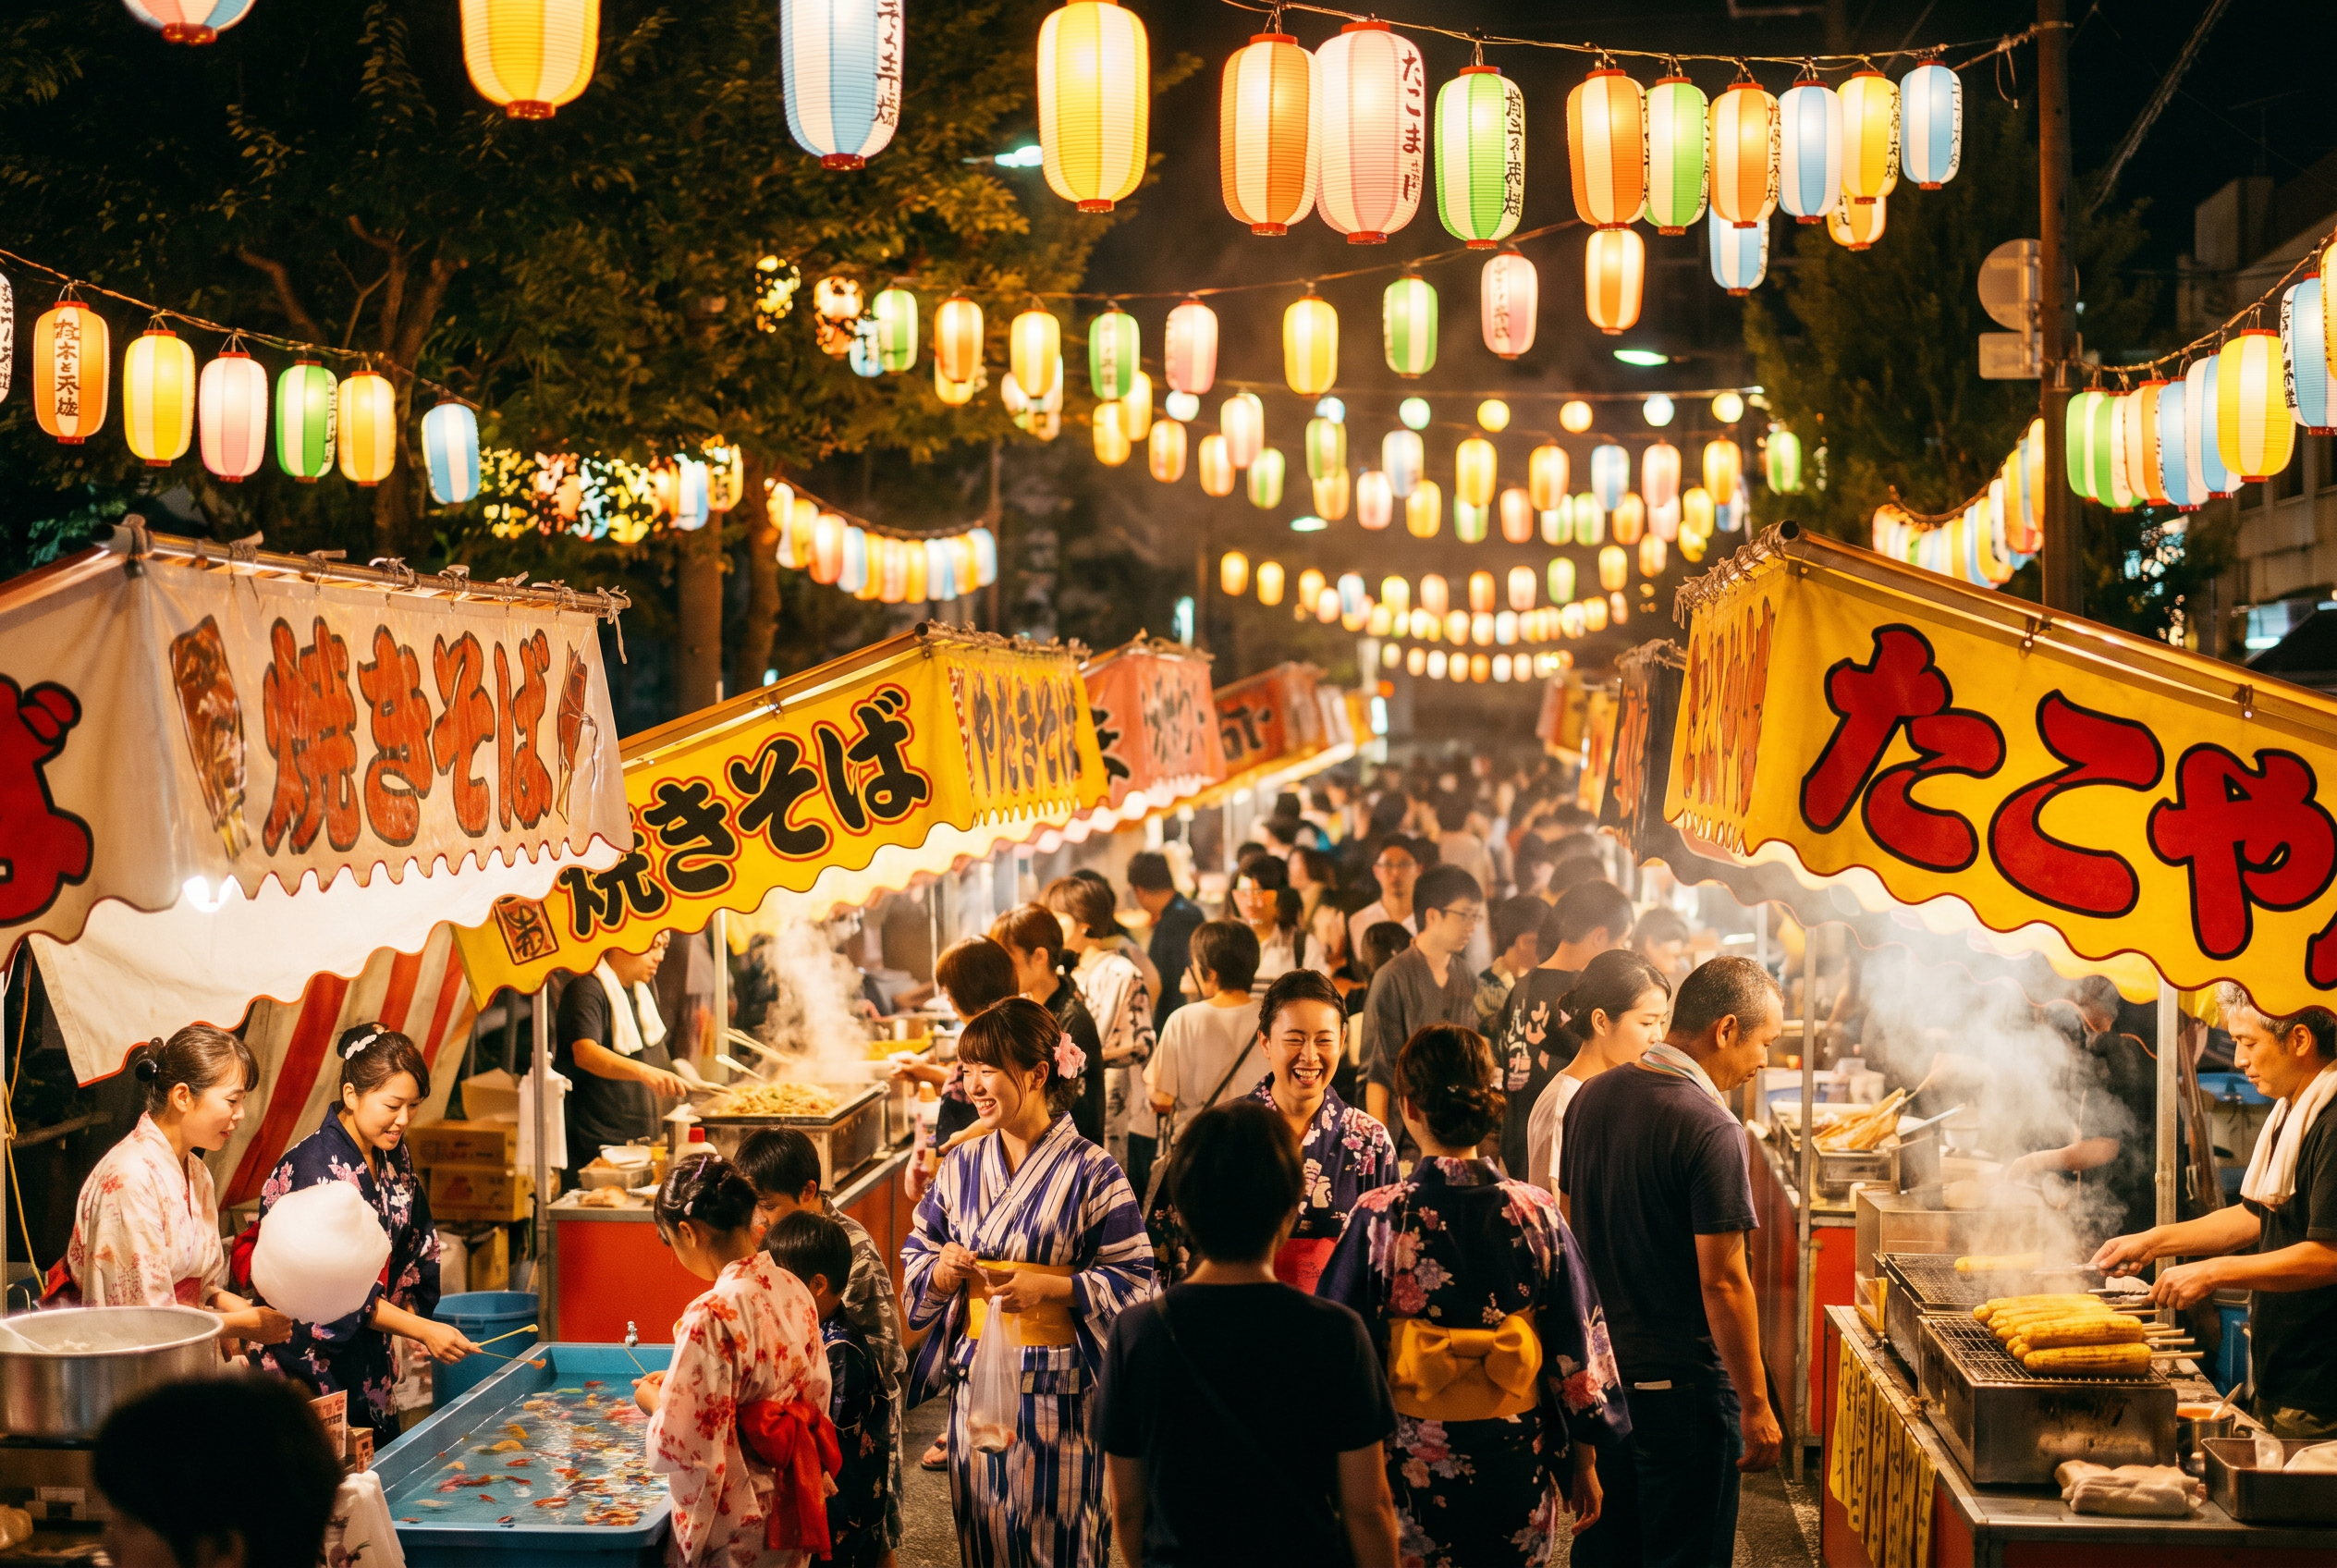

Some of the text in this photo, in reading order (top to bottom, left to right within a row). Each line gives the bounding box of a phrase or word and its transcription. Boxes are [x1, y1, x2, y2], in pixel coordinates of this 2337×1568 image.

[263, 615, 553, 857] 焼きそば
[1799, 622, 2337, 991] たこや
